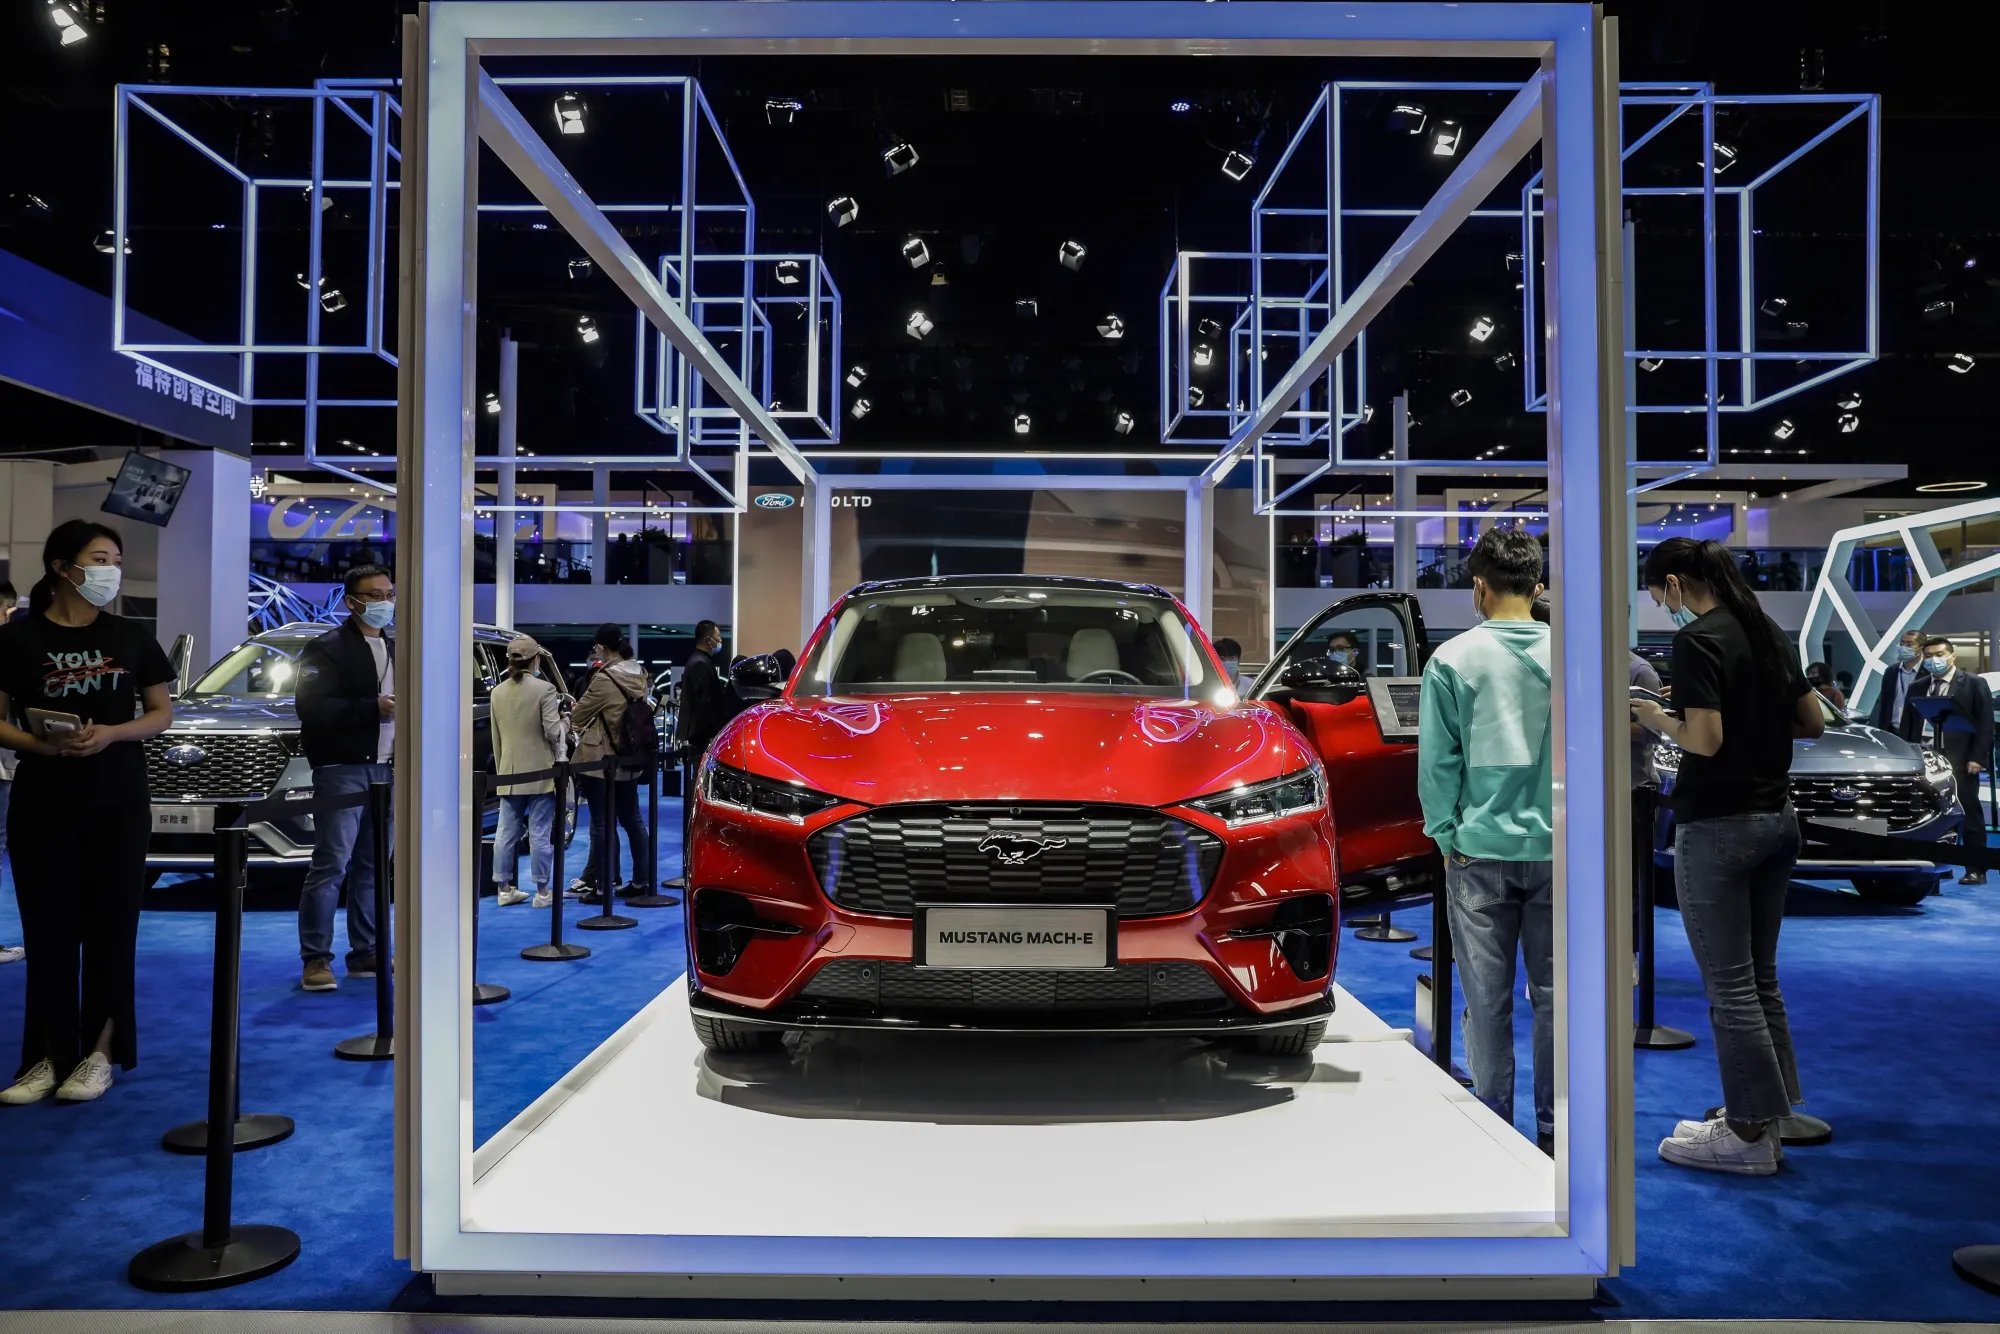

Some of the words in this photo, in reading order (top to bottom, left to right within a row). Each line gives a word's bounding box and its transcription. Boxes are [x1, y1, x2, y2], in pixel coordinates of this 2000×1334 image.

[843, 496, 872, 507] LTD
[47, 650, 104, 669] YOU
[939, 931, 1022, 944] MUSTANG
[1026, 932, 1093, 945] MACH-E
